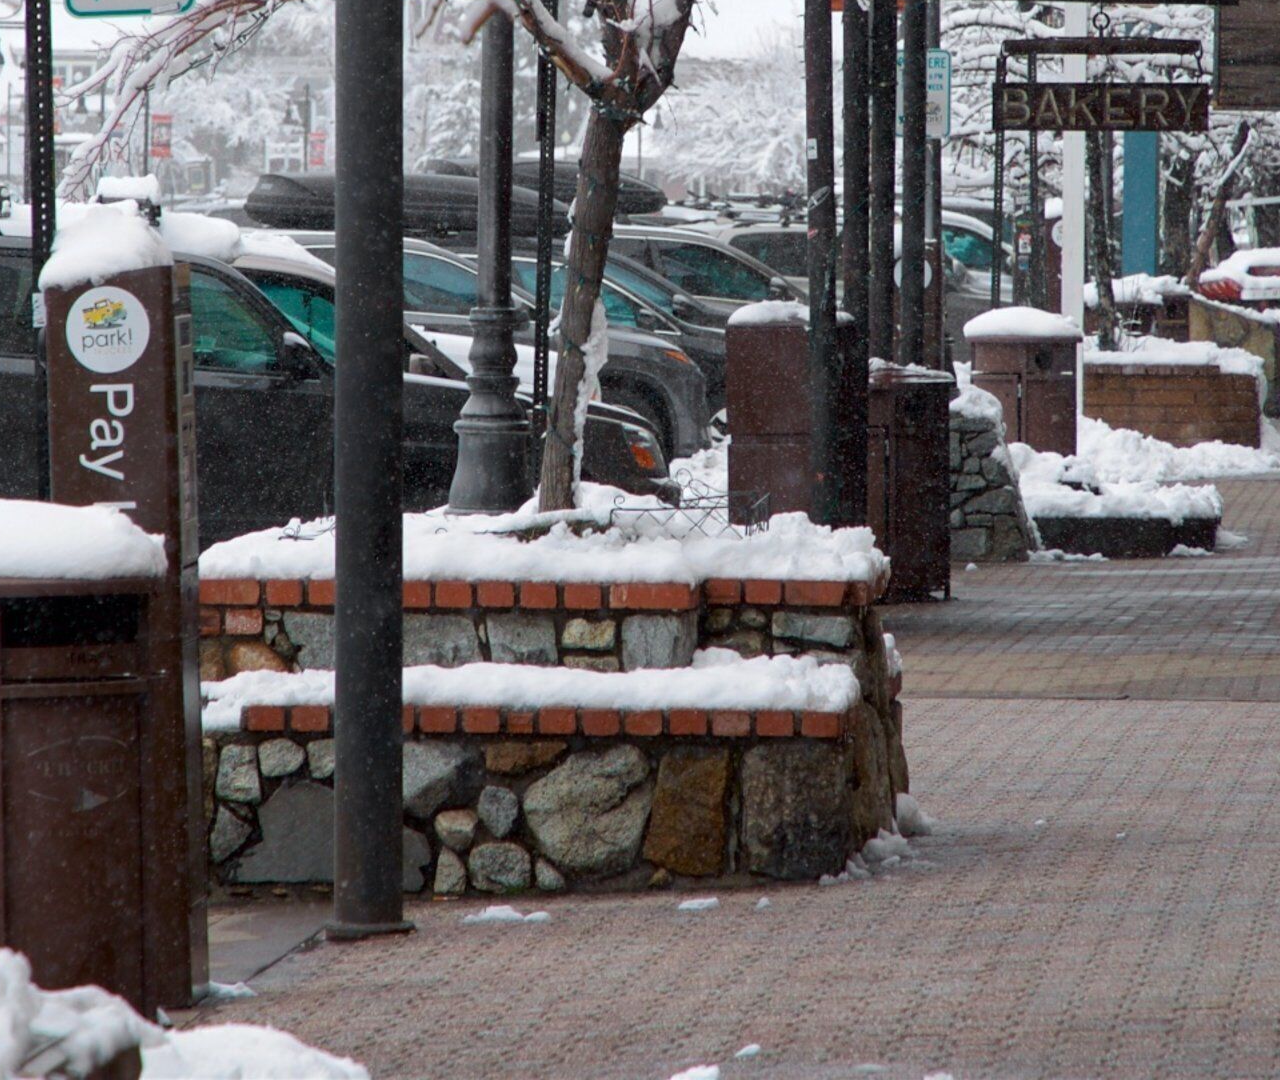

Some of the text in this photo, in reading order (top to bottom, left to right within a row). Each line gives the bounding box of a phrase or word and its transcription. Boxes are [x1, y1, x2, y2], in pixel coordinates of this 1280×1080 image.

[1001, 86, 1203, 128] BAKERY
[82, 328, 132, 353] park!
[79, 383, 134, 480] Pay
